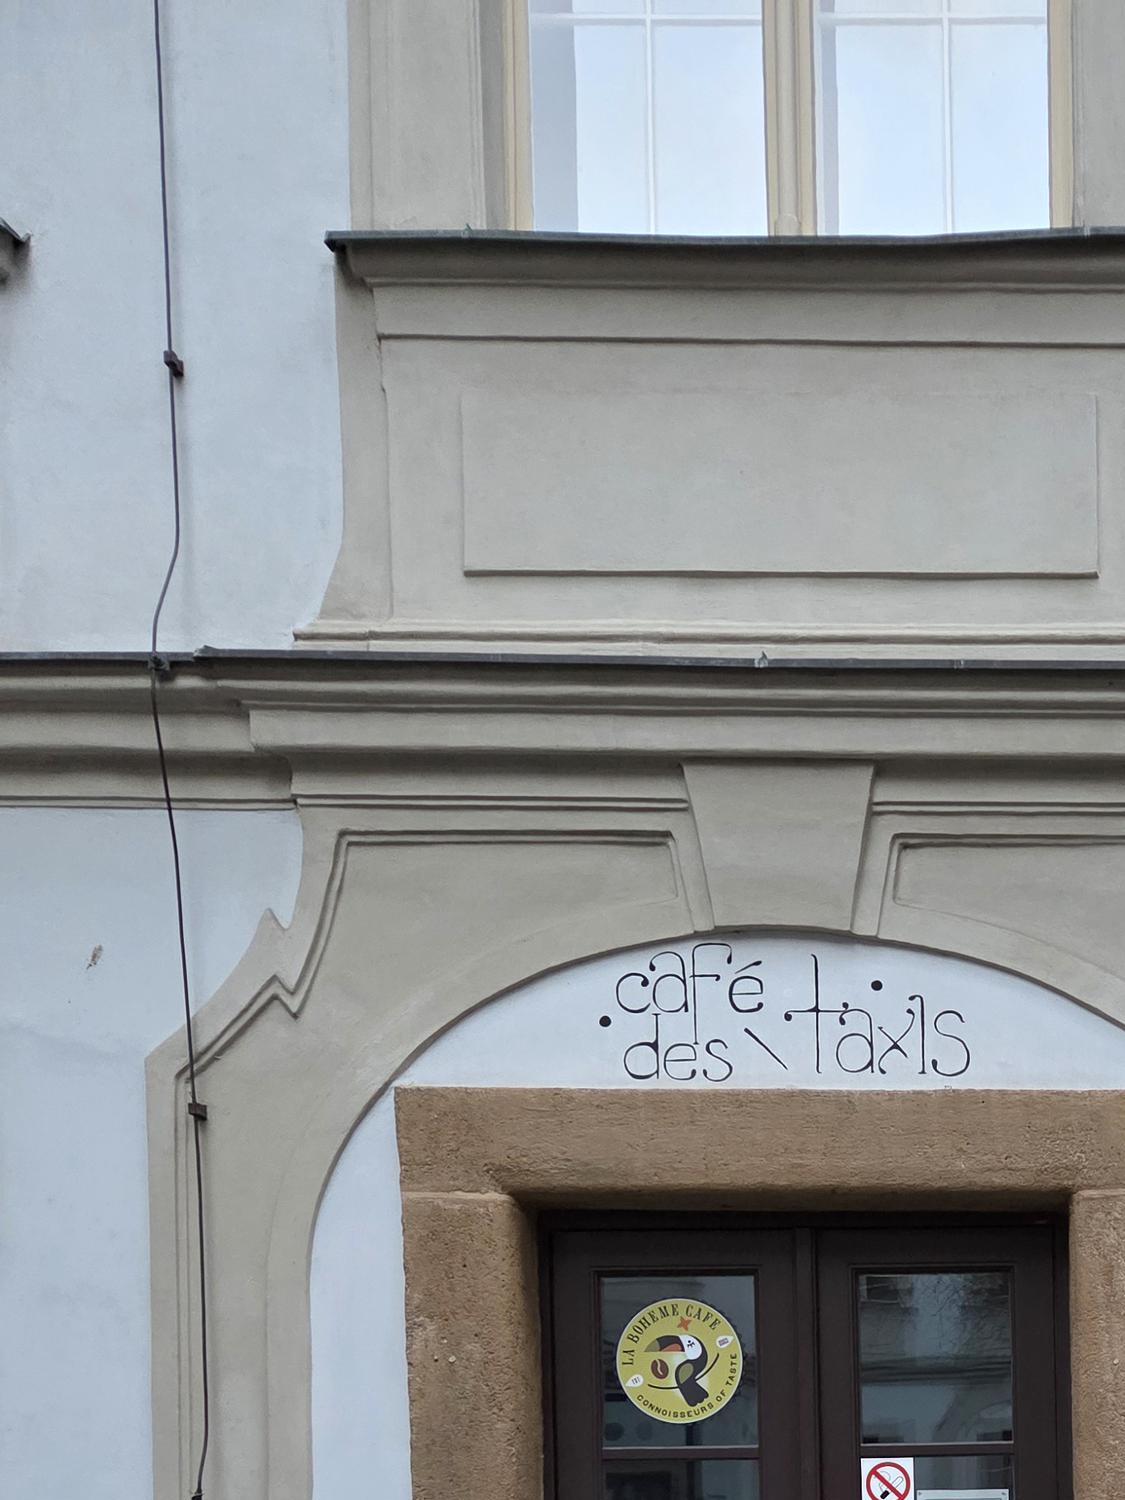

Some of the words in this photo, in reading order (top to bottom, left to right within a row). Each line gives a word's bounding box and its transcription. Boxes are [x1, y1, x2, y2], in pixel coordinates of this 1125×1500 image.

[615, 943, 764, 1044] café
[623, 1013, 733, 1082] des
[784, 953, 970, 1076] taxis
[627, 1303, 680, 1344] BOHEME
[685, 1303, 721, 1331] CAFE
[622, 1349, 635, 1366] LA
[637, 1394, 714, 1418] CONNOISSEURS
[715, 1389, 727, 1402] OF
[725, 1353, 737, 1386] TASTE
